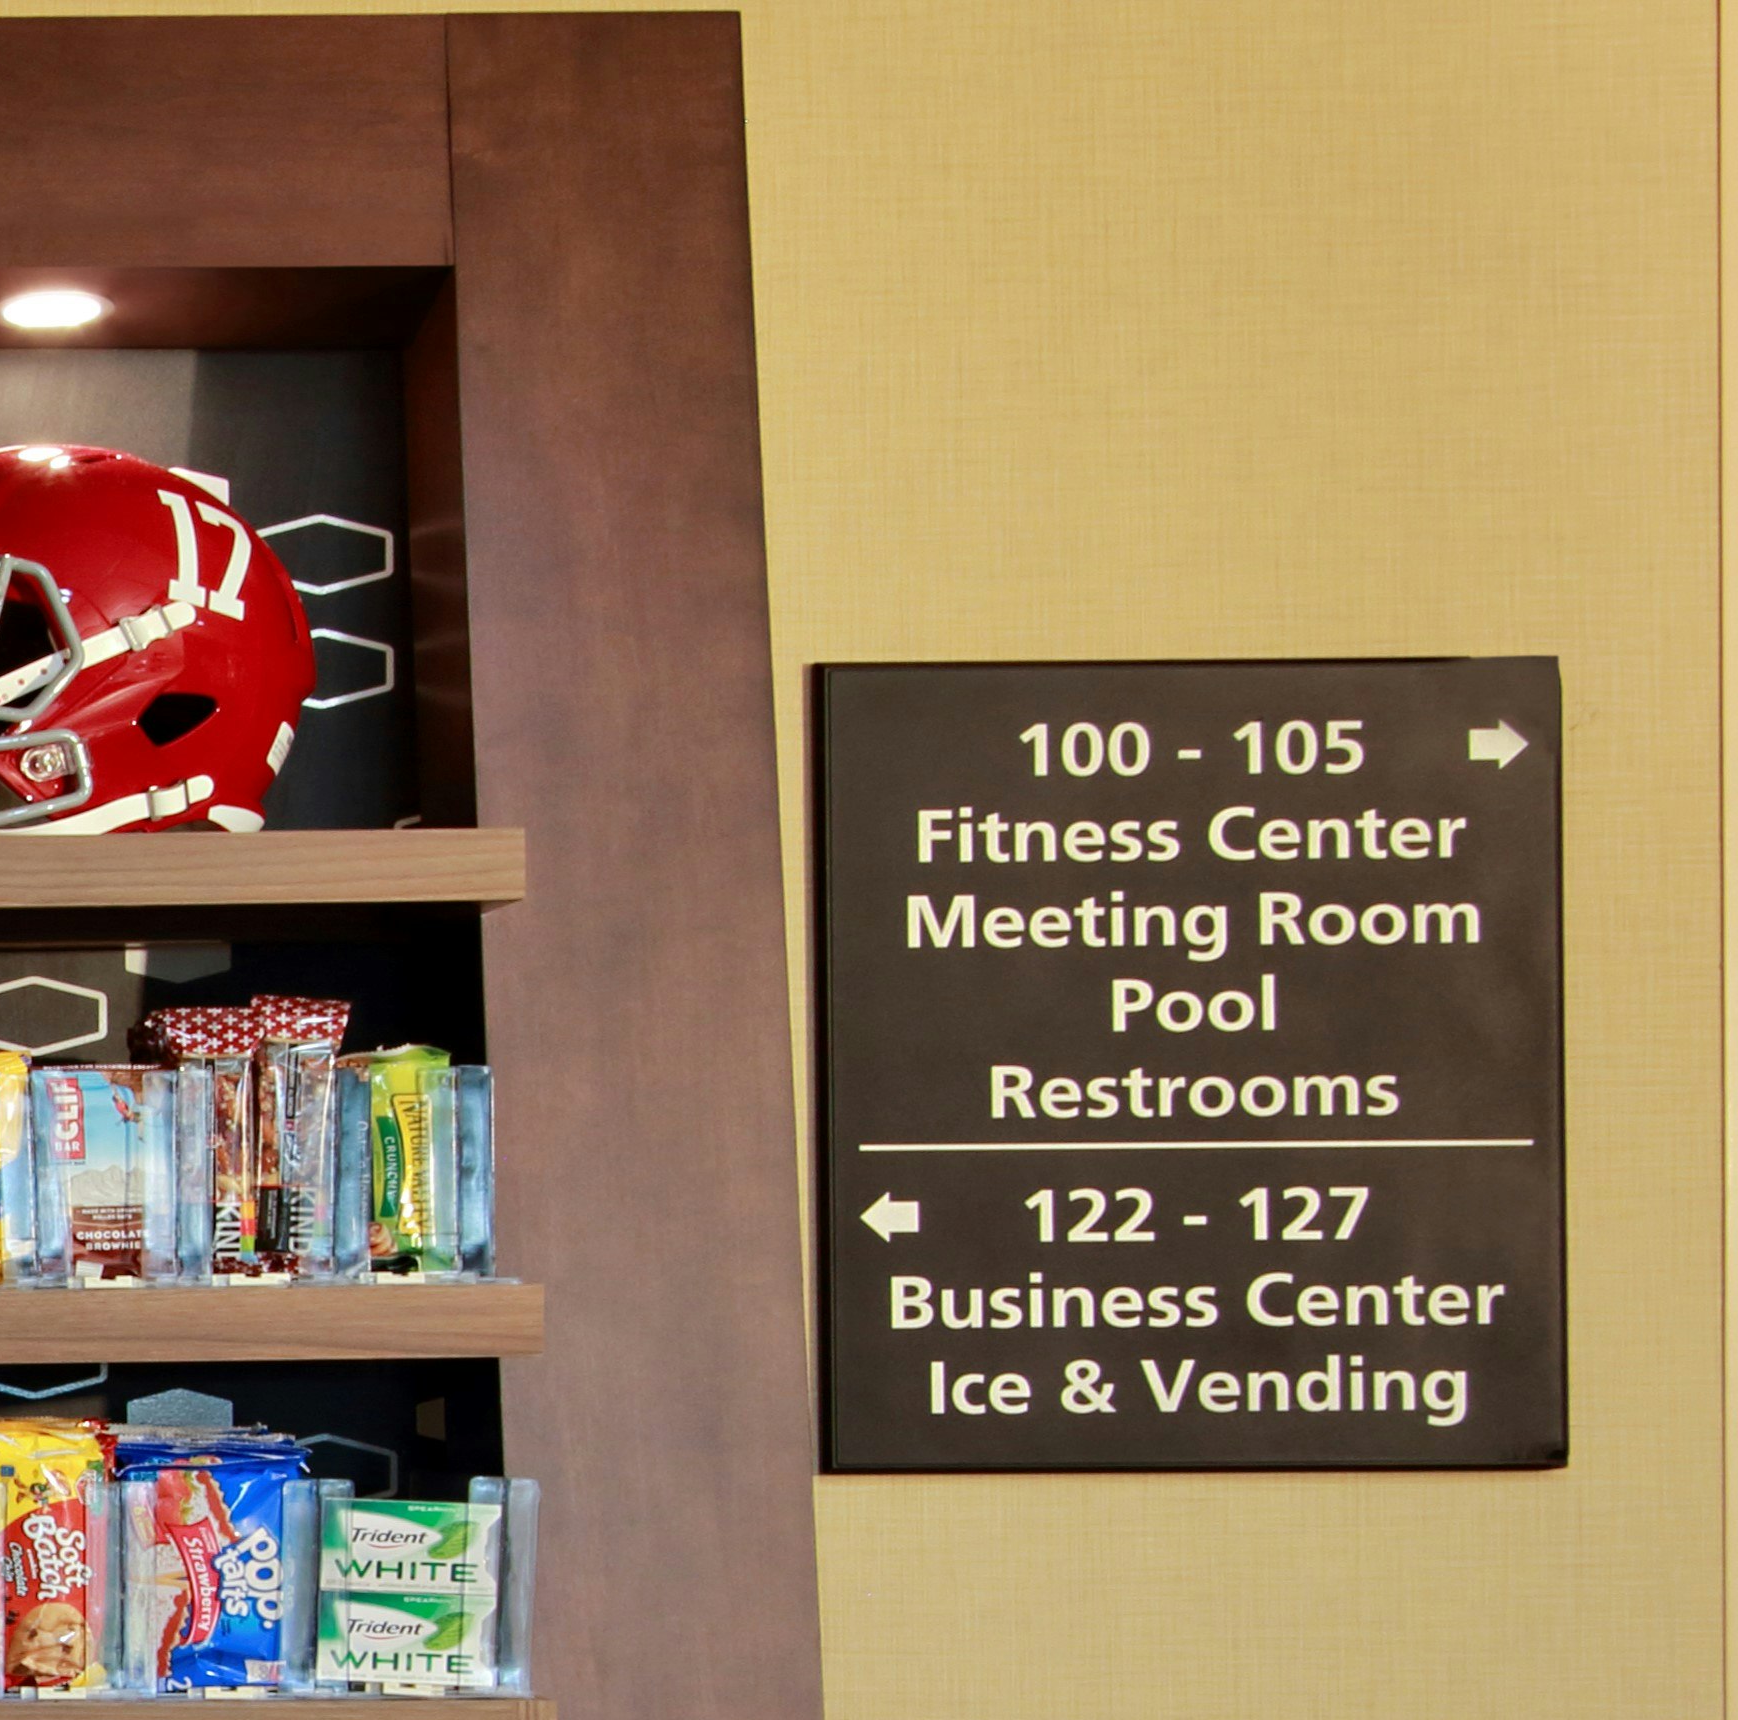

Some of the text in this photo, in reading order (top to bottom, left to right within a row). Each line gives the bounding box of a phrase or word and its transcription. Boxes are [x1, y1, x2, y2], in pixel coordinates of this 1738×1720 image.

[158, 489, 253, 623] 17
[1018, 721, 1151, 778] 100
[1232, 719, 1365, 776] 105
[916, 805, 1466, 863] Fitness Center
[905, 890, 1481, 962] Meeting Room
[1110, 973, 1277, 1033] Pool
[51, 1077, 80, 1142] CLIF
[989, 1065, 1400, 1119] Restrooms
[54, 1140, 81, 1152] BAR
[384, 1136, 399, 1199] CRUNCHY
[1023, 1187, 1156, 1244] 122
[1237, 1186, 1370, 1242] 127
[85, 1240, 142, 1251] BROWNIE
[888, 1272, 1506, 1330] Business Center
[928, 1355, 1469, 1428] Ice & Vending
[23, 1514, 71, 1601] Batch
[55, 1527, 93, 1588] Soft
[351, 1527, 429, 1545] Trident
[183, 1536, 218, 1631] Strawberry
[213, 1548, 251, 1618] tarts
[335, 1559, 479, 1584] WHITE
[347, 1618, 425, 1636] Trident
[330, 1649, 475, 1675] WHITE
